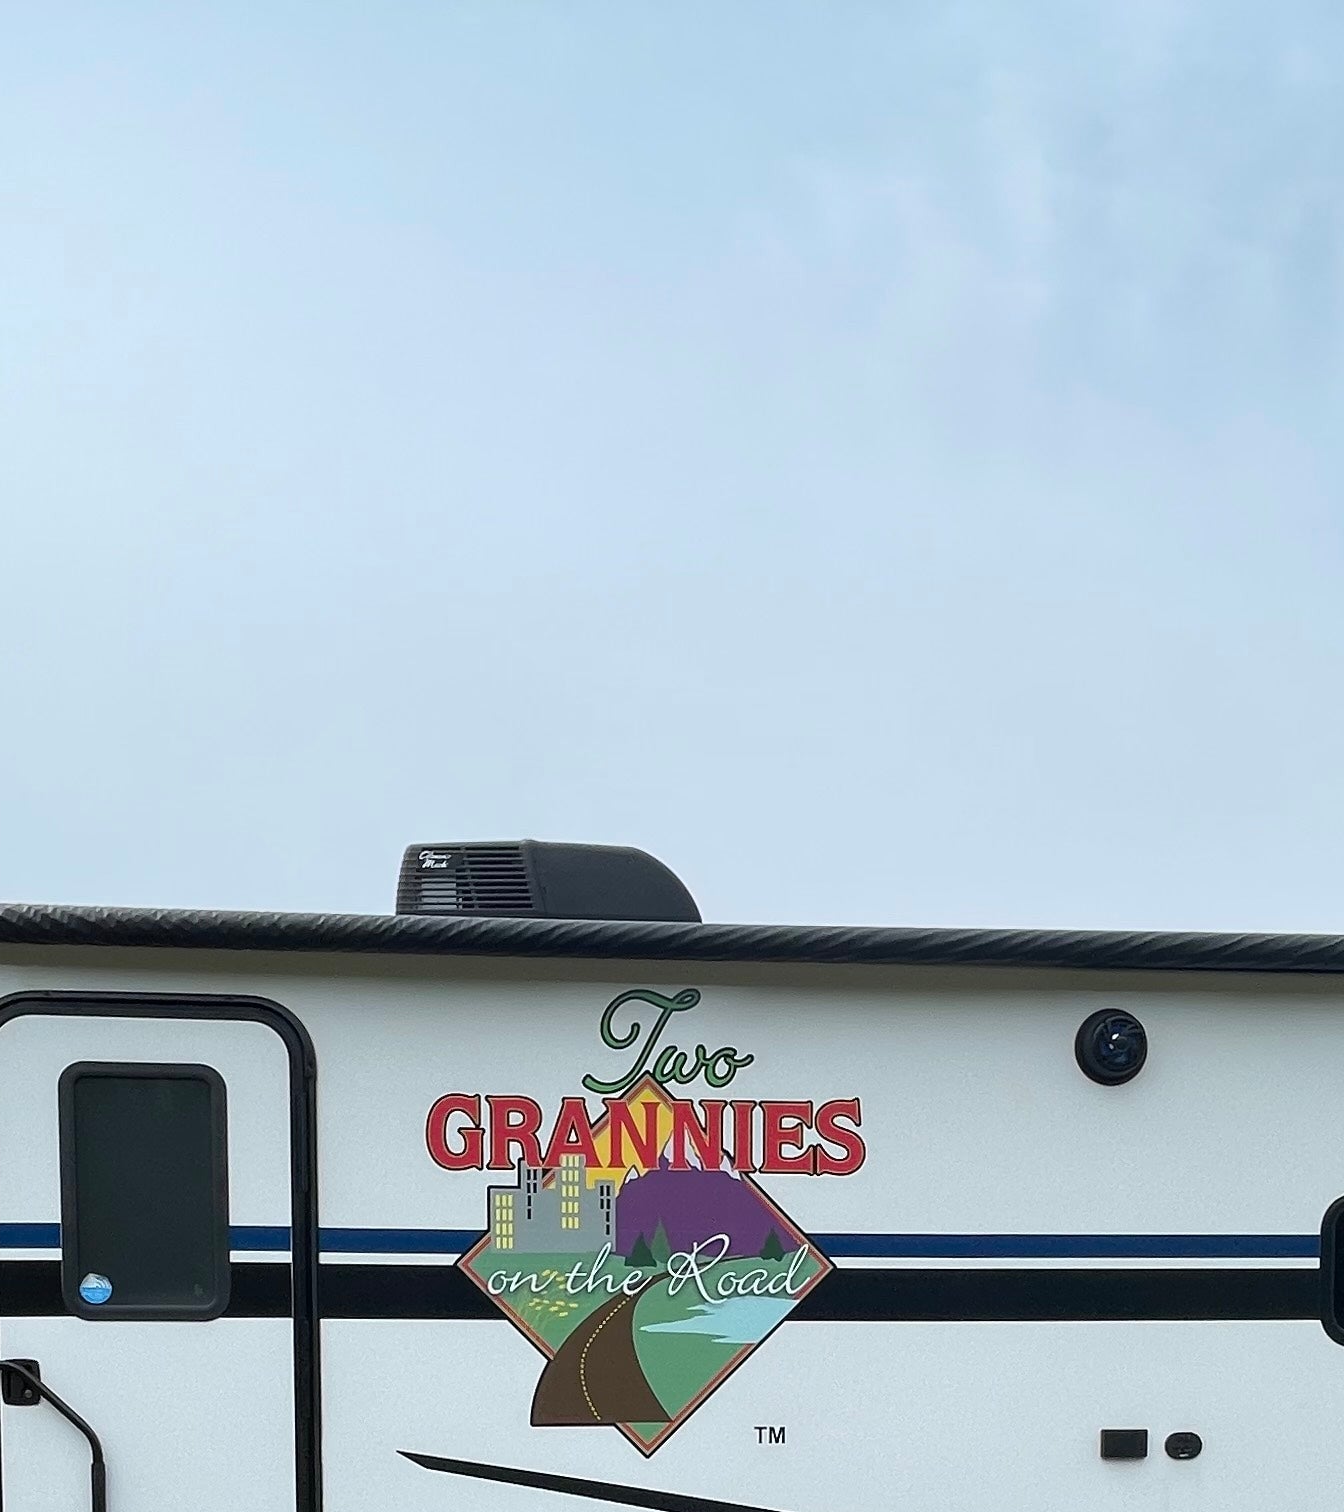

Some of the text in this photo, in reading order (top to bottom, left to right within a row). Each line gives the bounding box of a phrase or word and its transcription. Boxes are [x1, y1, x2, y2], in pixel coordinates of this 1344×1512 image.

[582, 988, 754, 1092] Two
[426, 1094, 866, 1176] GRANNIES
[488, 1233, 810, 1305] on the Road
[753, 1426, 786, 1444] TM
